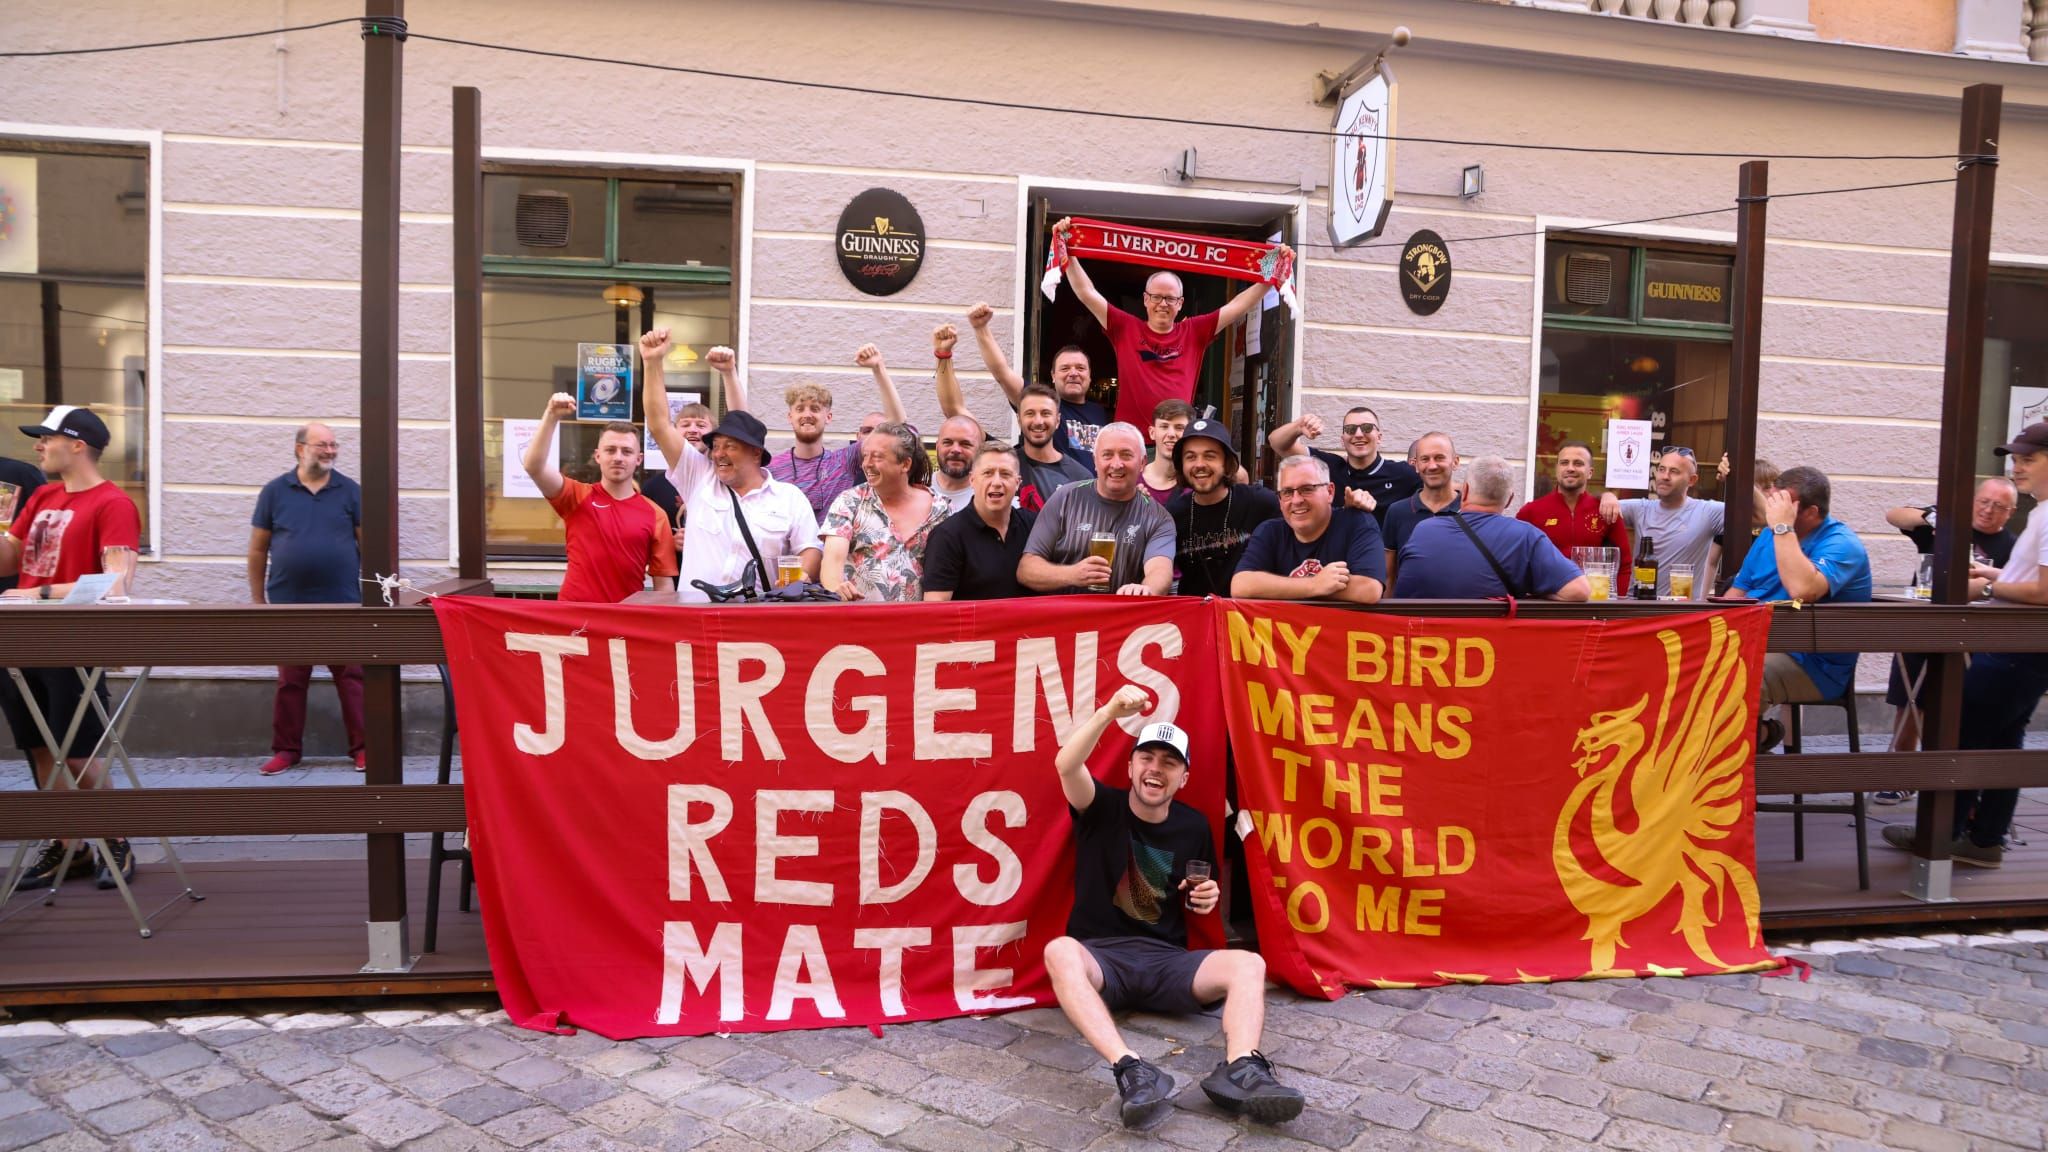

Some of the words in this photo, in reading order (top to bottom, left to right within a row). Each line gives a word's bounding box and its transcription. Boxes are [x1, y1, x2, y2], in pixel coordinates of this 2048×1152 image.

[842, 232, 919, 256] GUINNESS
[1103, 231, 1198, 259] LIVERPOOL
[1205, 245, 1227, 262] FC
[1405, 243, 1448, 264] STRONGBOW
[1648, 281, 1721, 302] GUINNESS
[584, 365, 609, 373] WORLD
[587, 356, 623, 367] RUGBY
[1227, 610, 1321, 675] MY
[1346, 631, 1496, 688] BIRD
[504, 621, 1184, 766] JURGENS
[1247, 680, 1473, 760] MEANS
[1272, 748, 1404, 817] THE
[666, 783, 1028, 907] REDS
[1254, 810, 1476, 878] WORLD
[1273, 876, 1330, 934] O
[1356, 884, 1446, 936] ME
[656, 920, 1036, 1025] MATE
